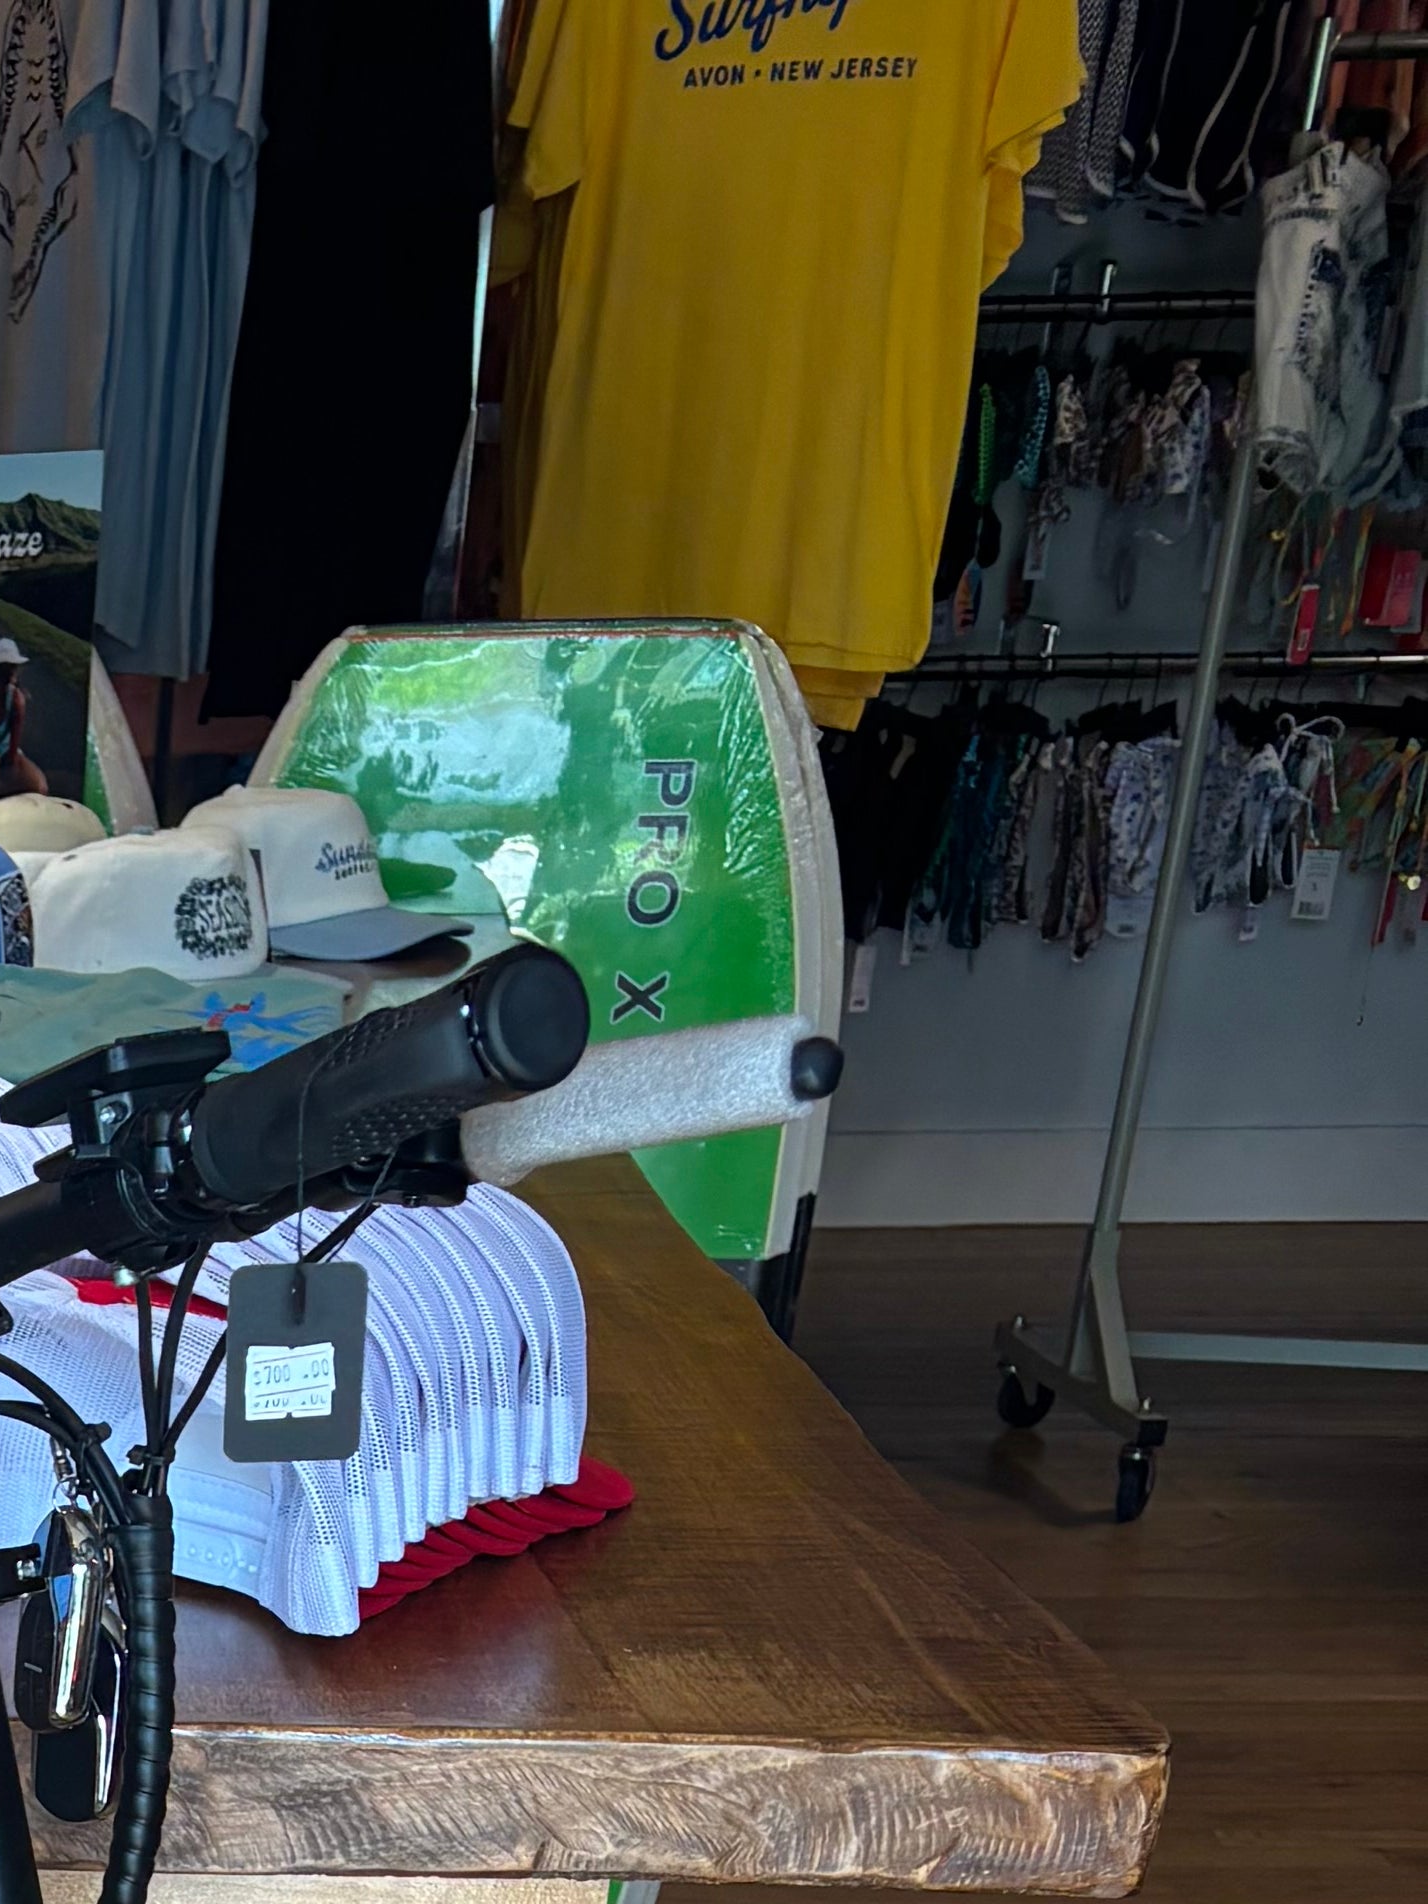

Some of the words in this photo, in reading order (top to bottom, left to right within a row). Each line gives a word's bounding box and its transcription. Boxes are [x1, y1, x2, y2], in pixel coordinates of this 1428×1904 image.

[683, 64, 746, 88] AVON
[769, 59, 824, 82] NEW
[830, 56, 918, 80] JERSEY
[626, 758, 697, 929] PRO
[609, 969, 671, 1026] X
